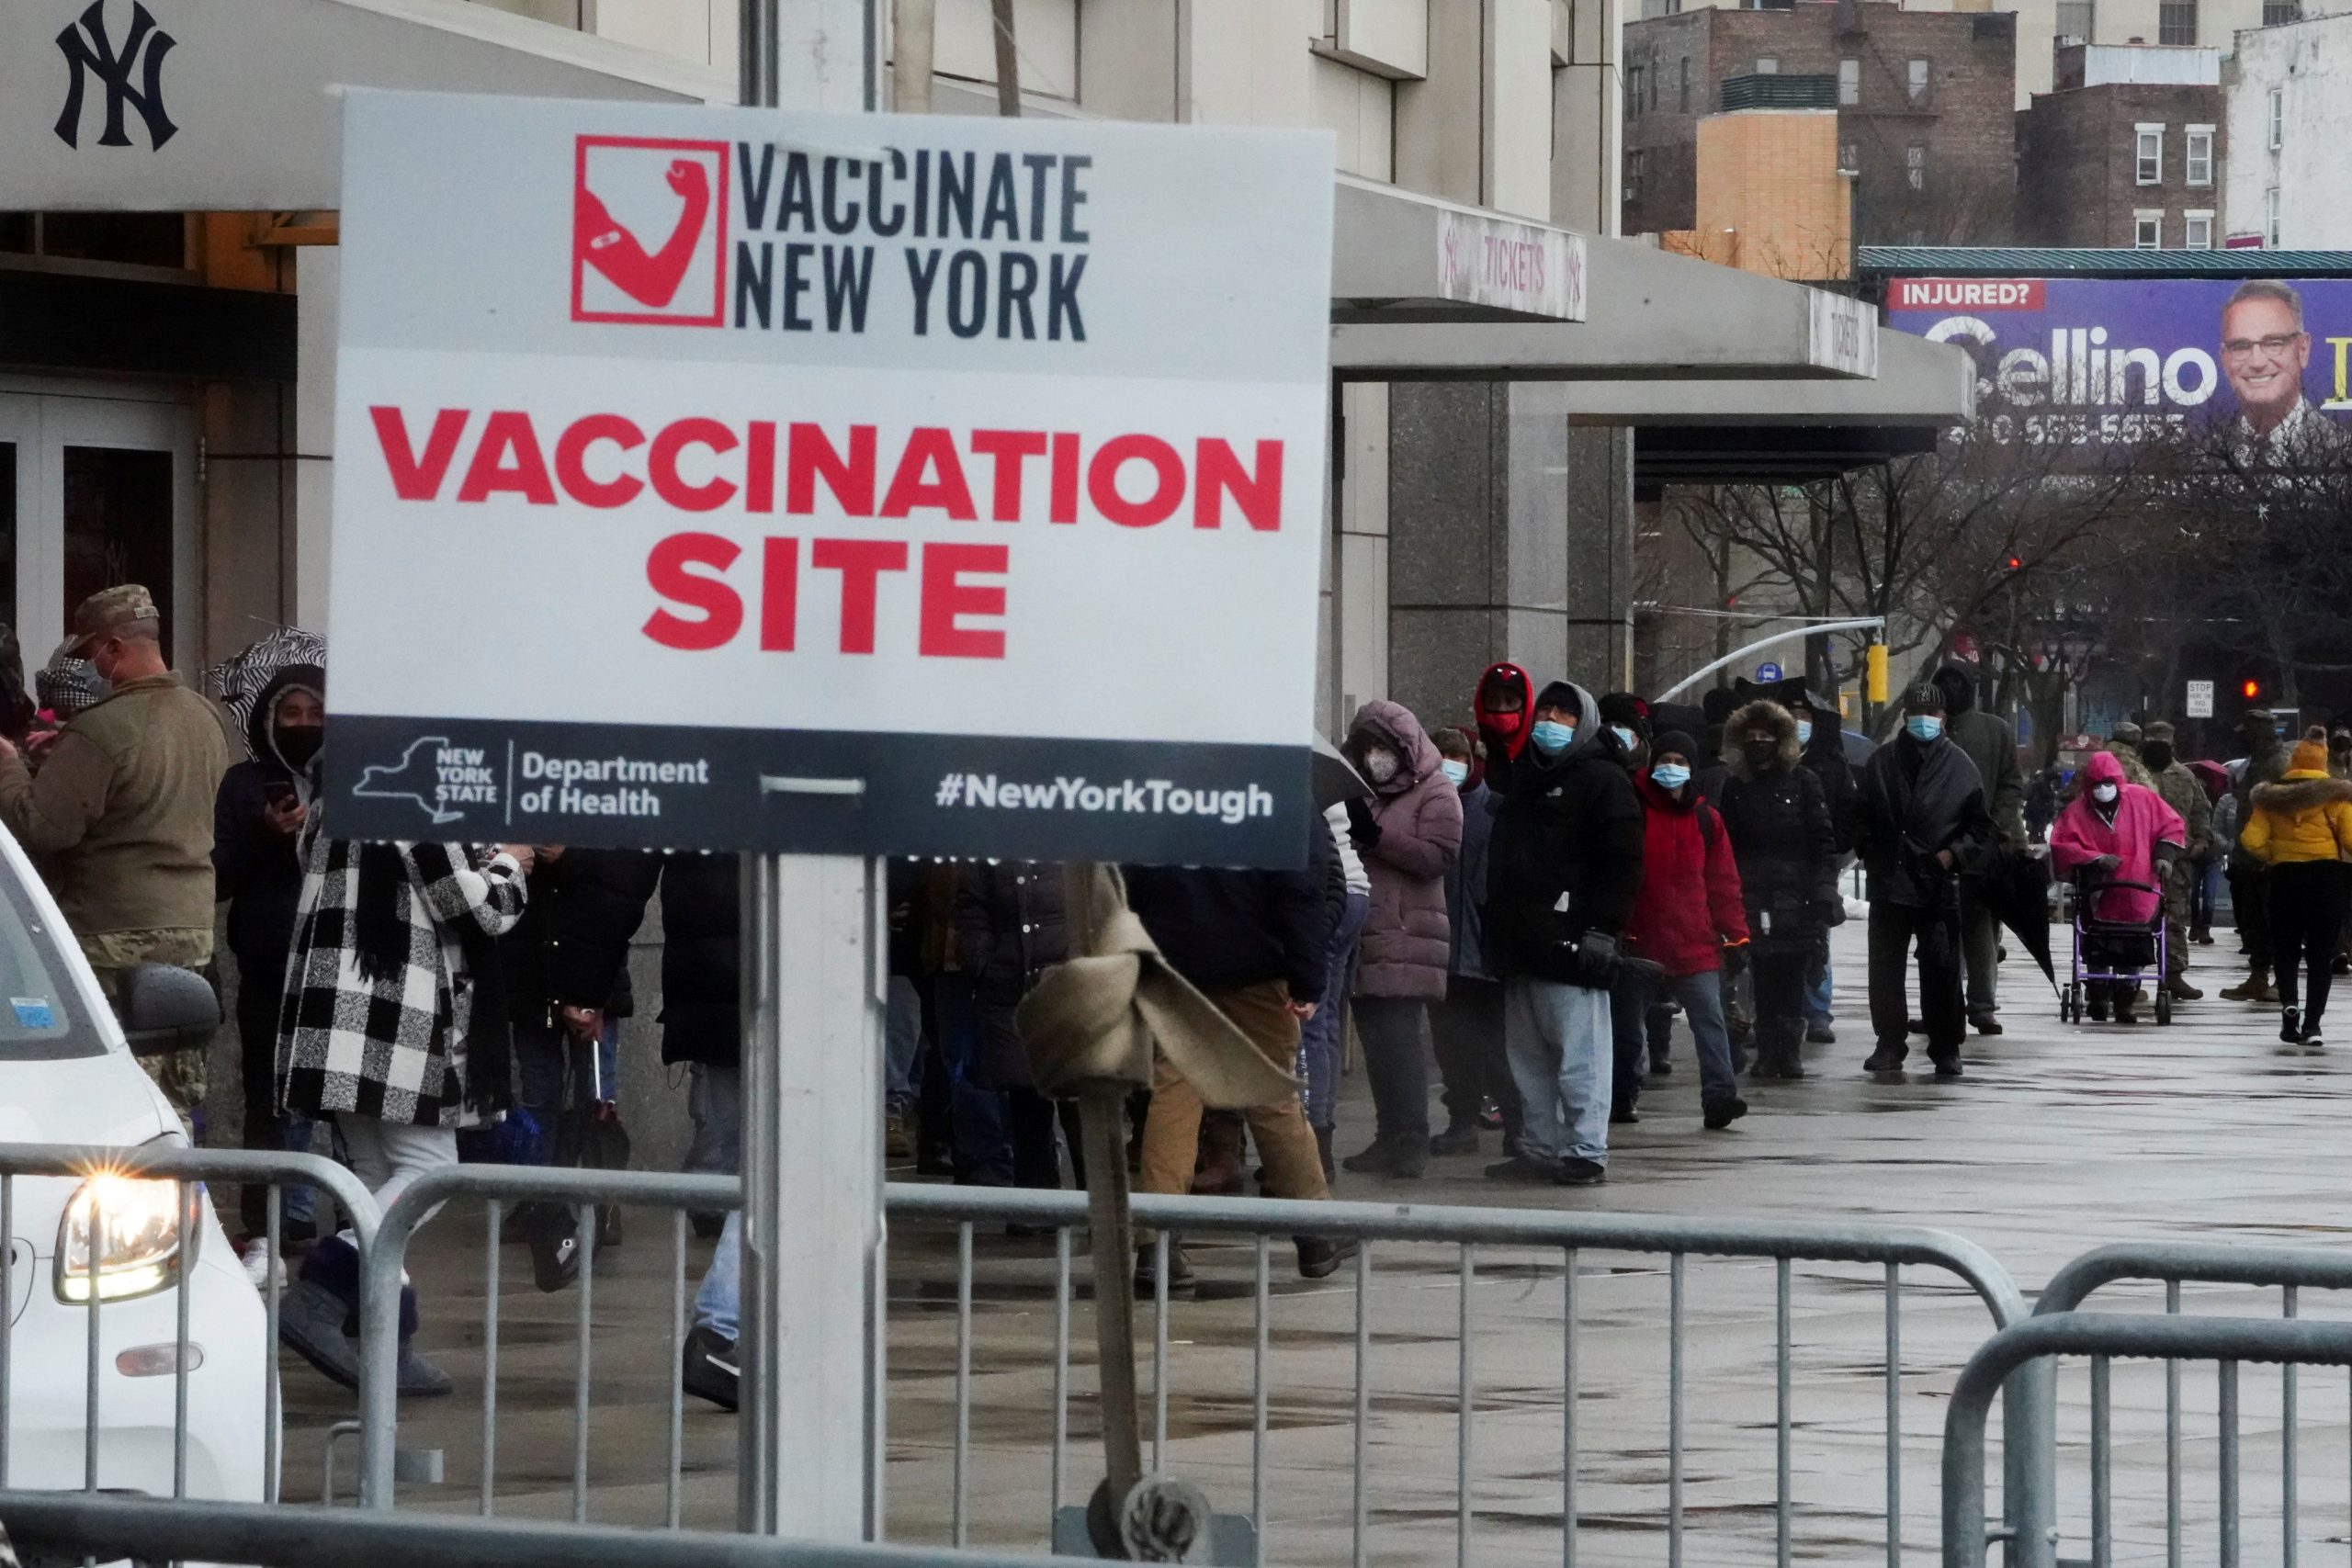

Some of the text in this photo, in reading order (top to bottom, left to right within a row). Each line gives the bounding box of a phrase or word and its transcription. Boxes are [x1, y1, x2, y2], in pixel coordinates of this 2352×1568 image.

[738, 141, 1091, 243] VACCINATE
[1484, 235, 1544, 296] TICKETS
[735, 242, 1089, 342] NEW YORK
[1903, 283, 2030, 306] INJURED?
[1924, 315, 2218, 407] Cellino
[368, 406, 1284, 533] VACCINATION
[640, 531, 1011, 660] SITE
[2189, 682, 2211, 692] STOP
[435, 765, 494, 785] YORK
[436, 748, 484, 766] NEW
[521, 751, 710, 786] Department
[435, 784, 498, 804] STATE
[520, 787, 662, 817] of Health
[934, 773, 1273, 825] #NewYorkTough
